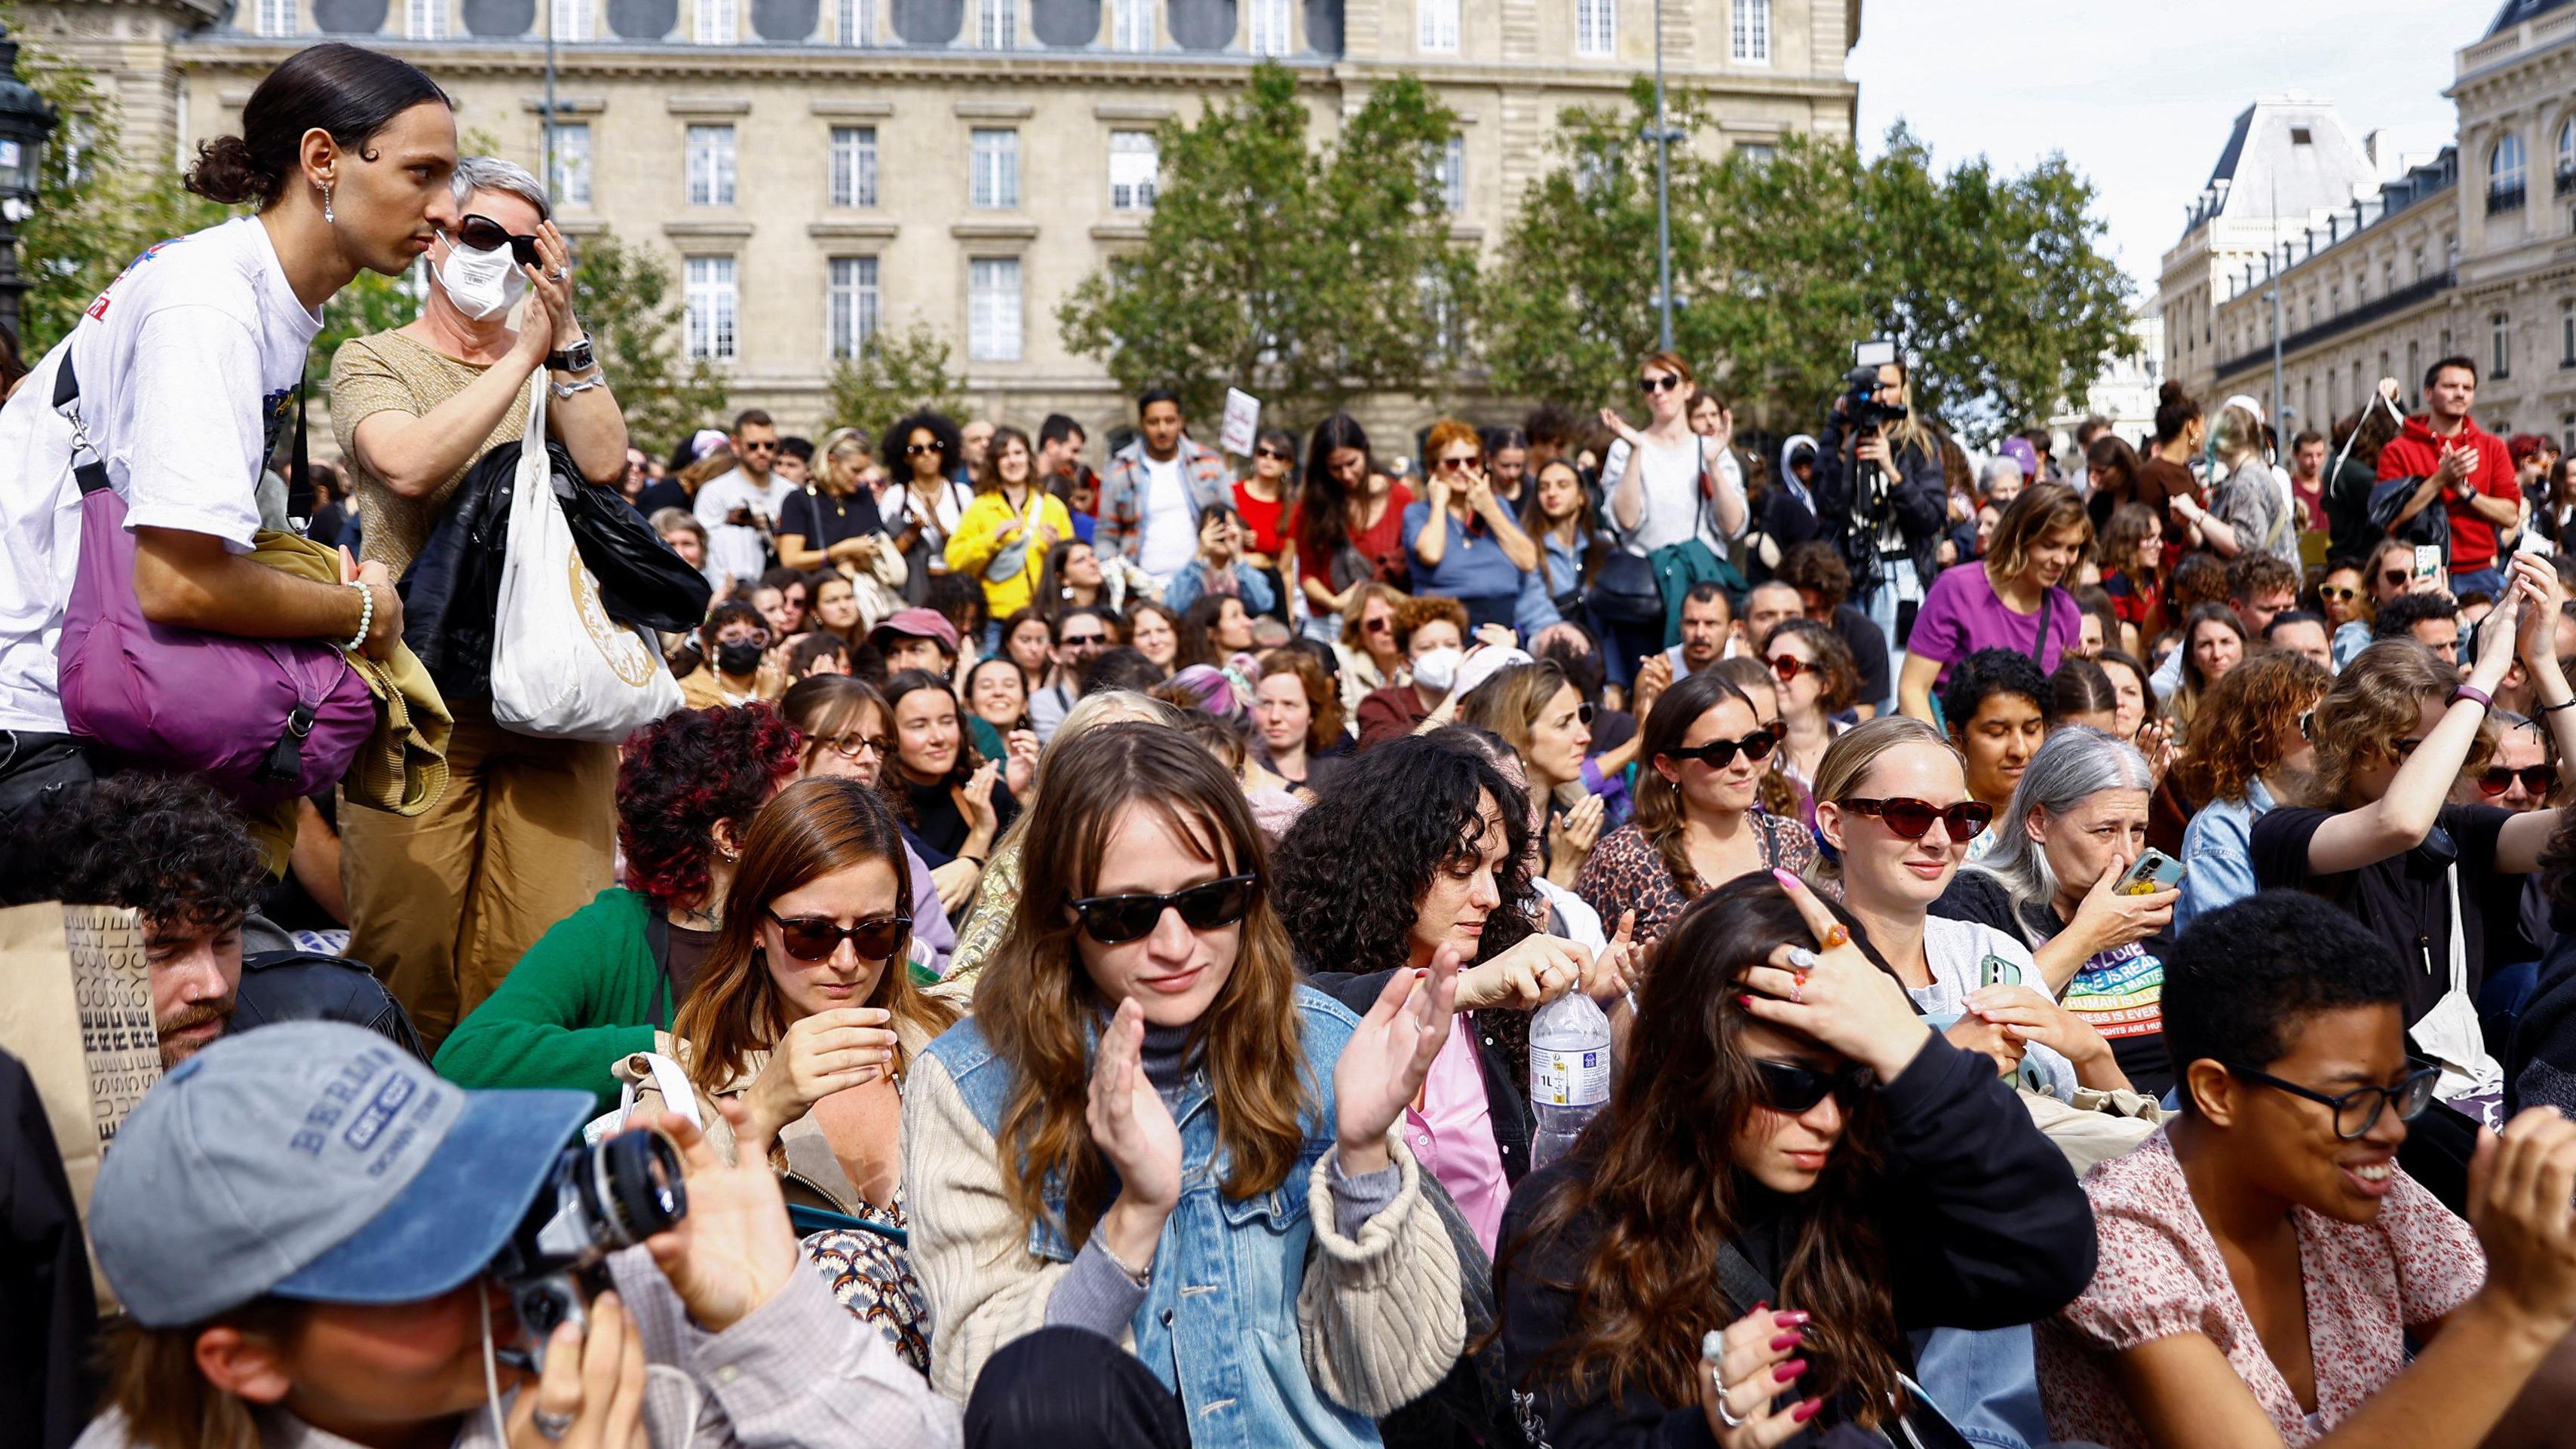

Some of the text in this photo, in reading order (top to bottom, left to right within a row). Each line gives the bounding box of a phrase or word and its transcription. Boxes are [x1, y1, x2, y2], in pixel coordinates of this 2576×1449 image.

[2105, 970, 2123, 985] IS
[2118, 955, 2161, 979] REAL
[72, 915, 112, 1052] RECYCLE
[108, 915, 146, 1049] RECYCLE
[2067, 995, 2118, 1009] HUMAN
[2121, 994, 2133, 1006] IS
[2111, 1010, 2125, 1021] IS
[2127, 1023, 2146, 1033] ARE
[1541, 1074, 1552, 1087] 1L
[290, 1048, 394, 1156] BERLIN
